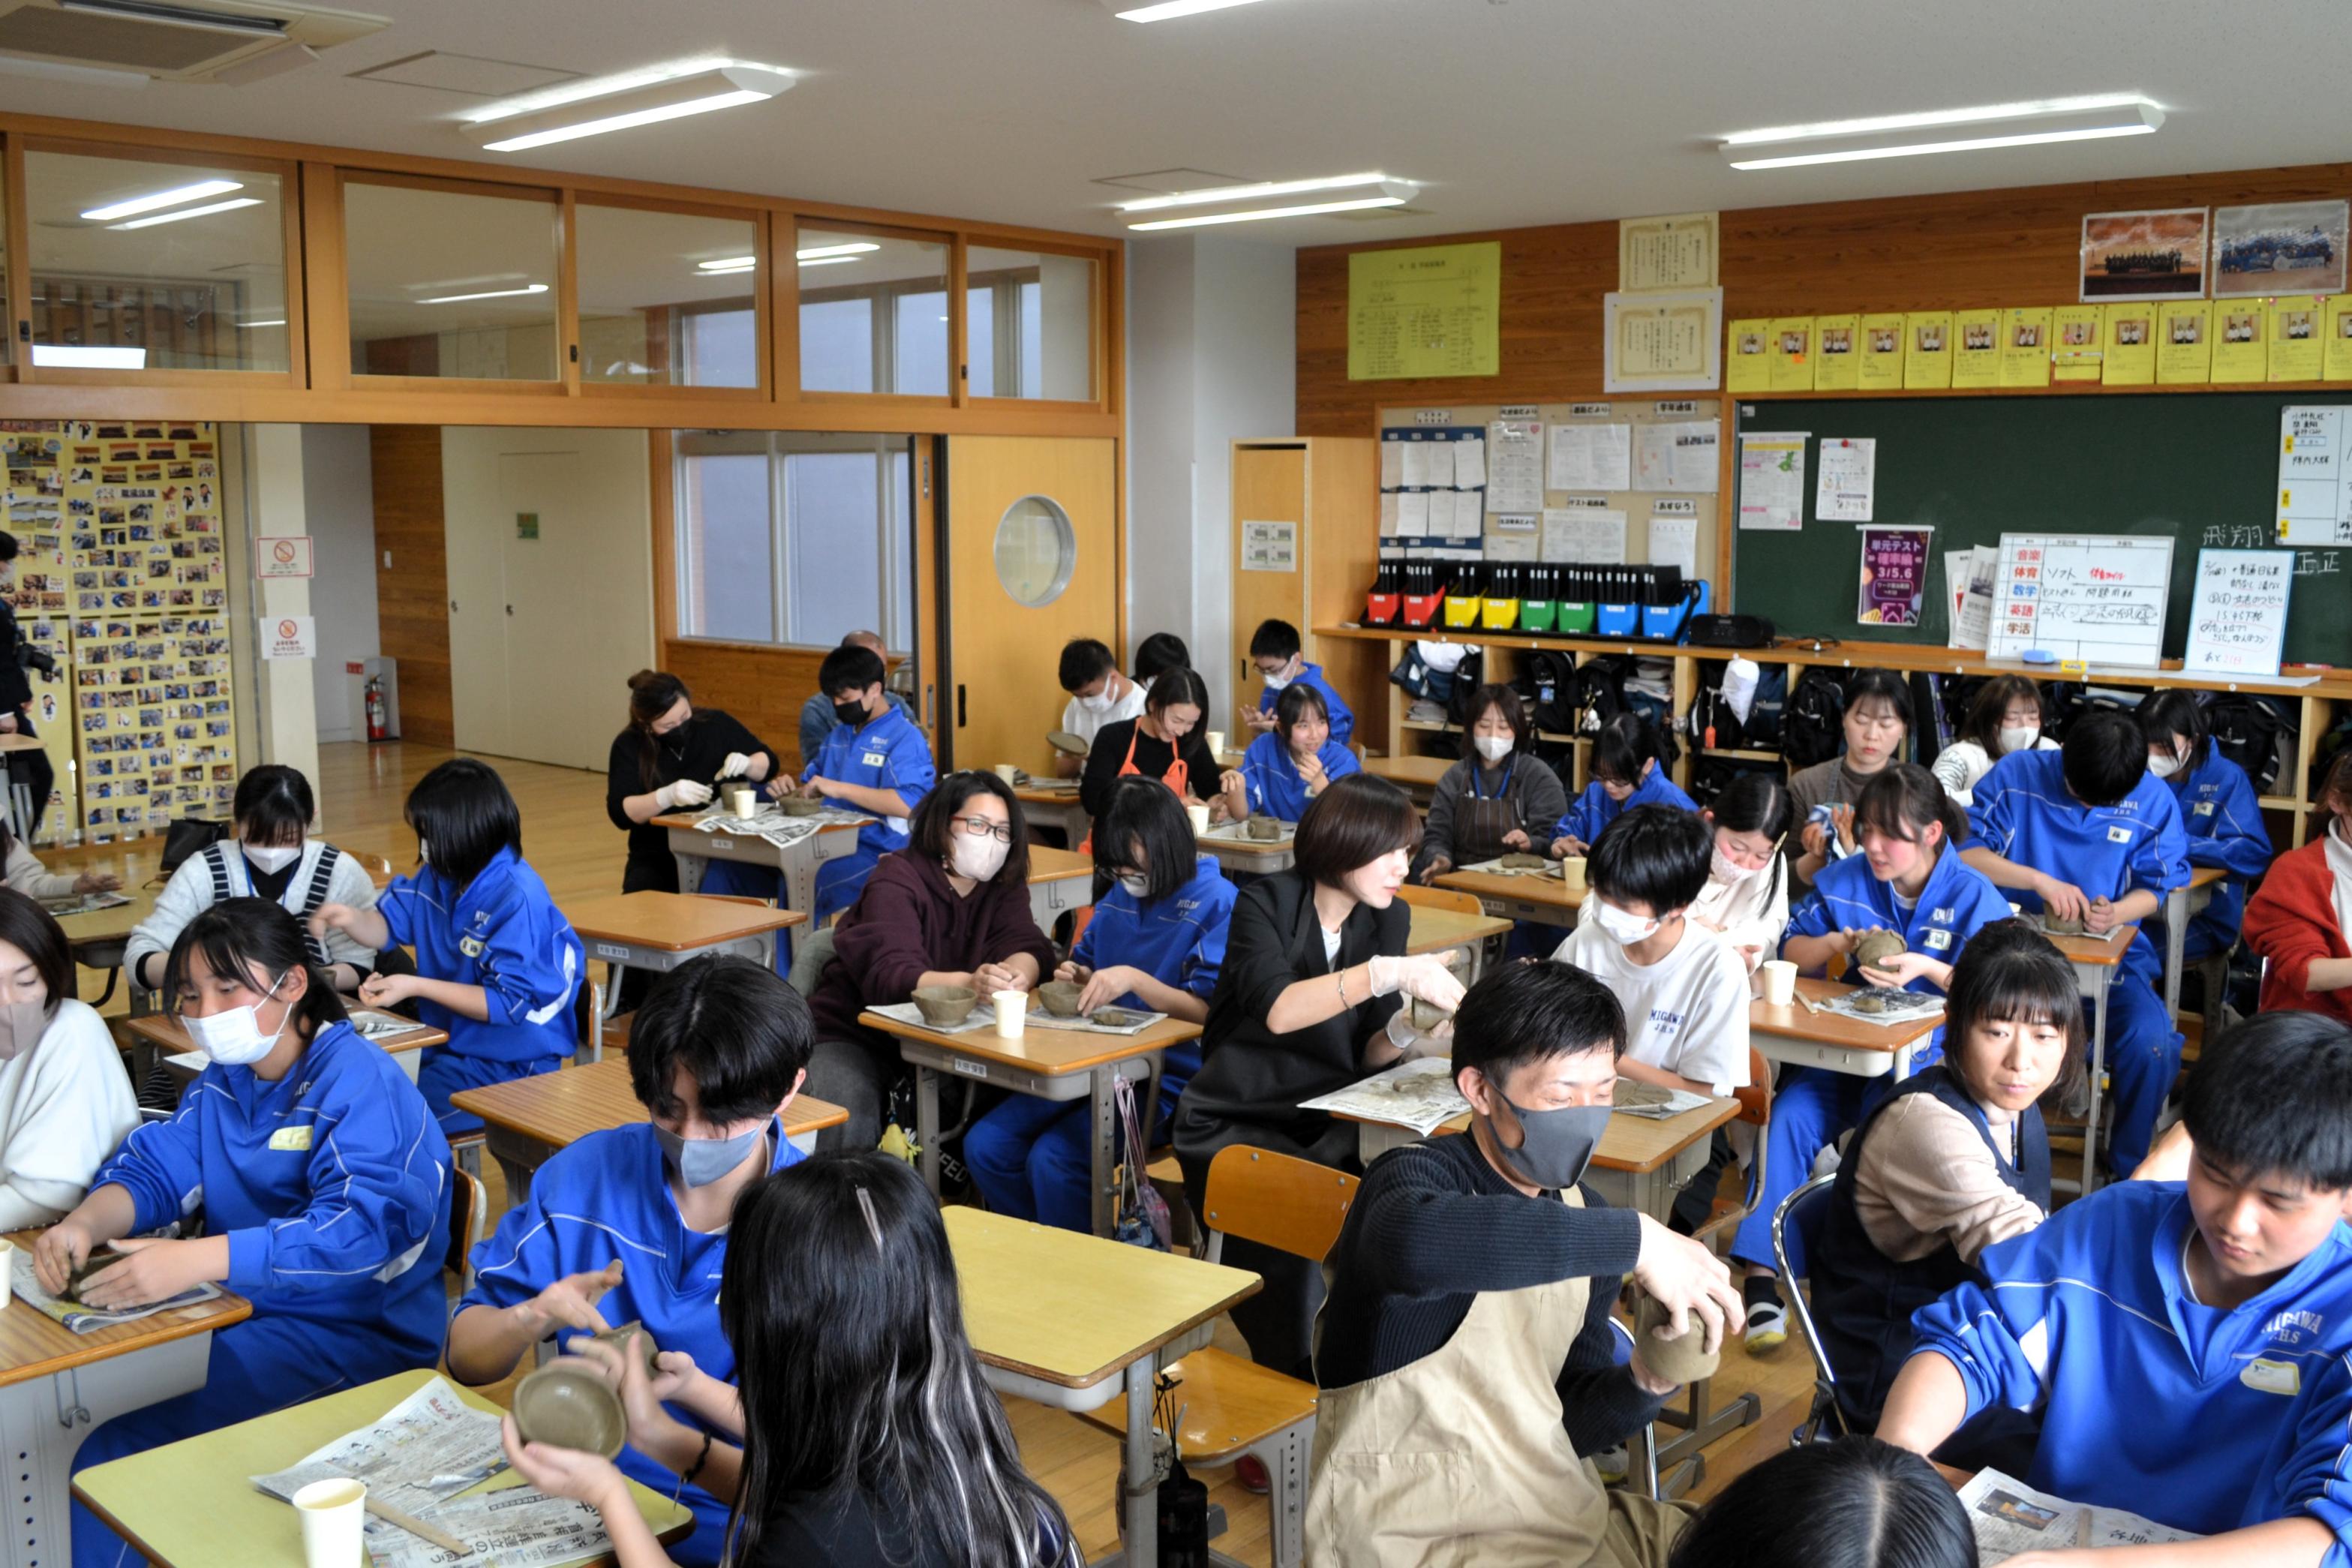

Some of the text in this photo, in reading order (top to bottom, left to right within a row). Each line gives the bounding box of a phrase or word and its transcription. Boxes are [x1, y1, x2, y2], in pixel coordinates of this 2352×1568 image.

[2203, 524, 2263, 548] 飛翔
[1871, 539, 1921, 551] 単元テスト
[2017, 549, 2041, 561] 音楽
[2014, 566, 2038, 579] 体育
[2013, 584, 2037, 596] 数学
[2010, 605, 2034, 617] 英語
[2006, 623, 2031, 635] 学活
